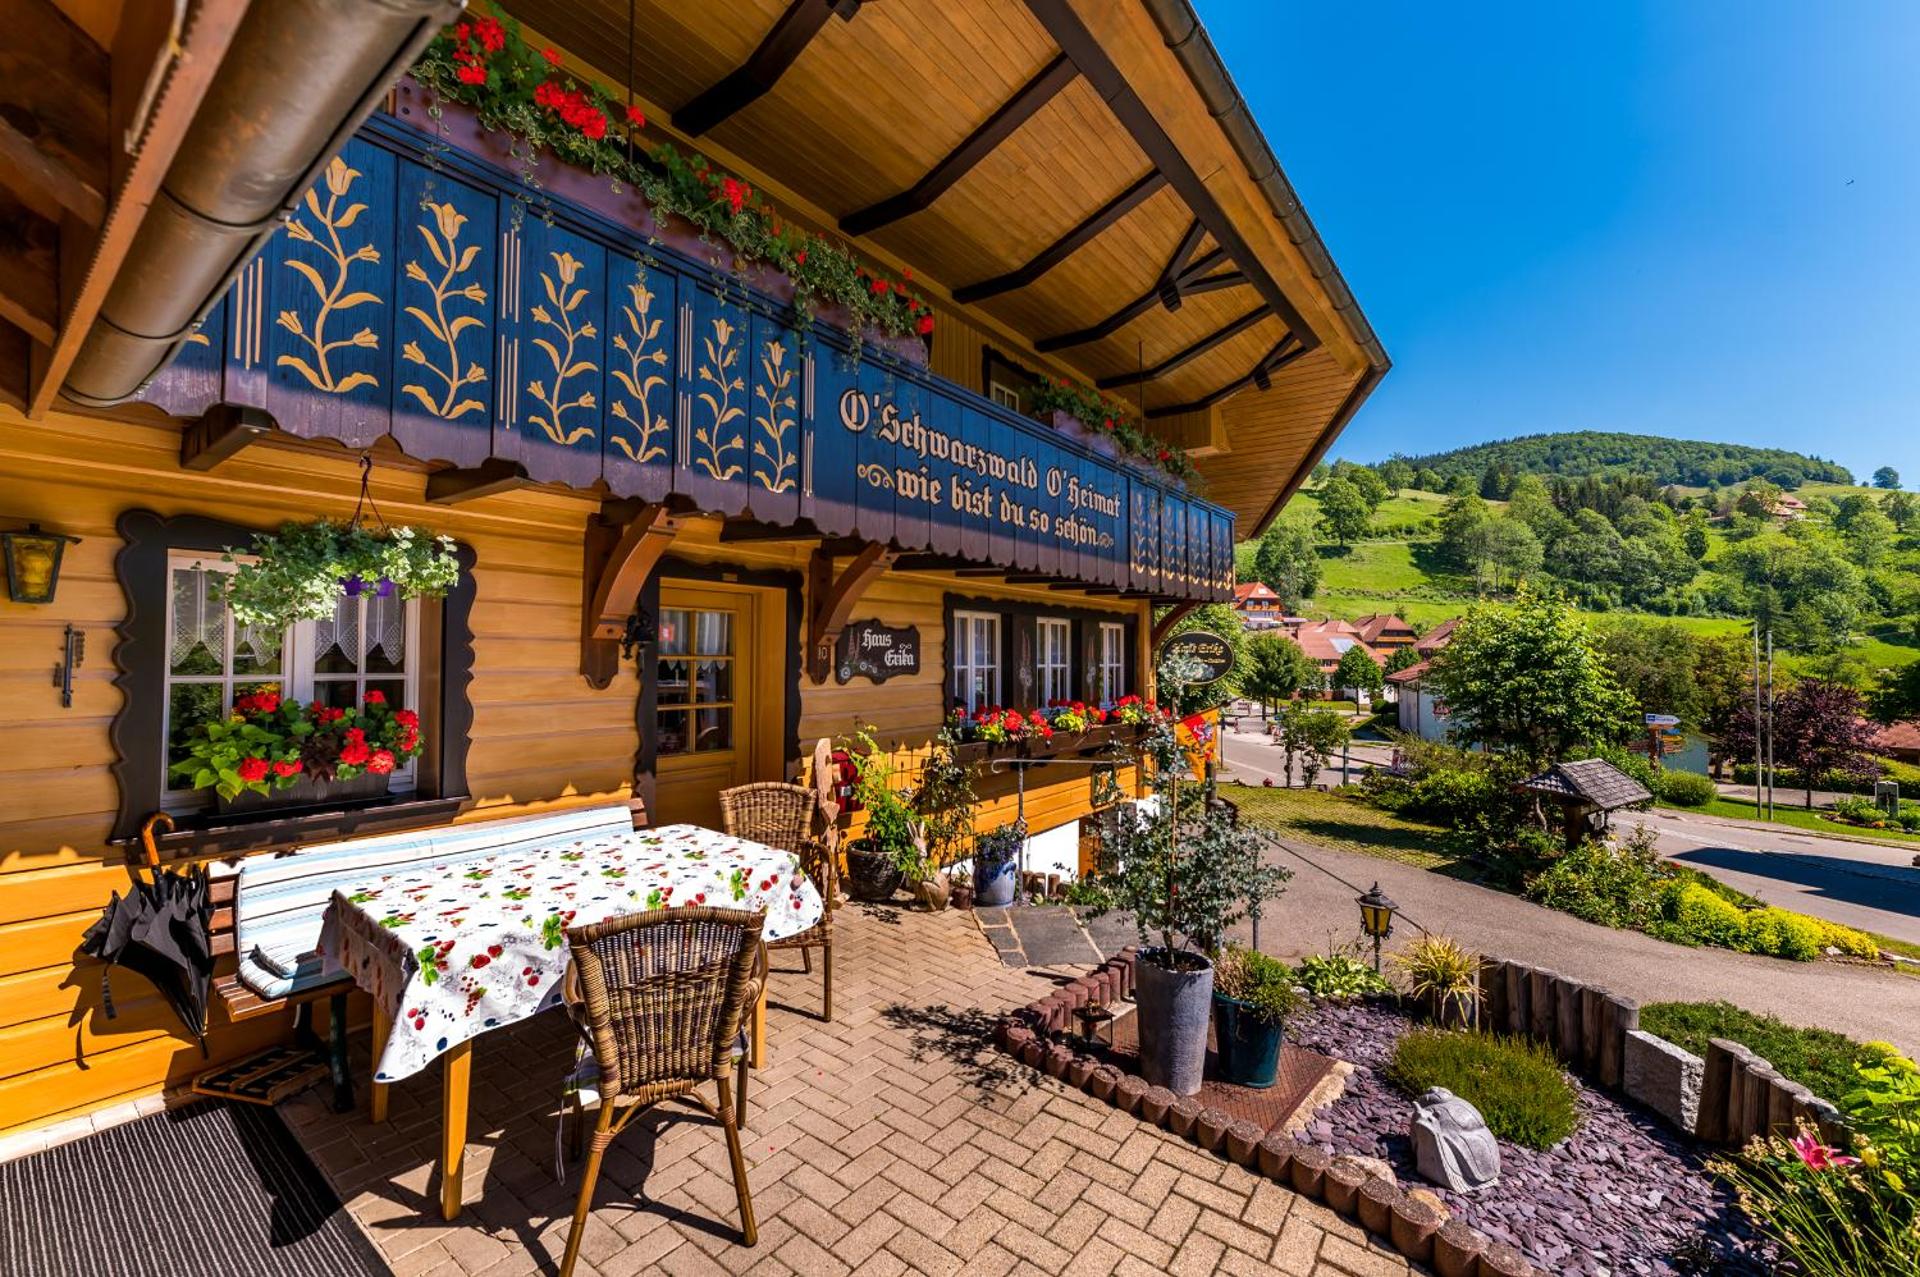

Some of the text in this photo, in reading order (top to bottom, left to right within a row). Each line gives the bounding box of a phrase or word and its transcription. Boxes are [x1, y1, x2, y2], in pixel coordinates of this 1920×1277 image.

[895, 466, 1099, 546] wie bist du so schön
[861, 628, 892, 651] Haus
[884, 648, 915, 667] Erika
